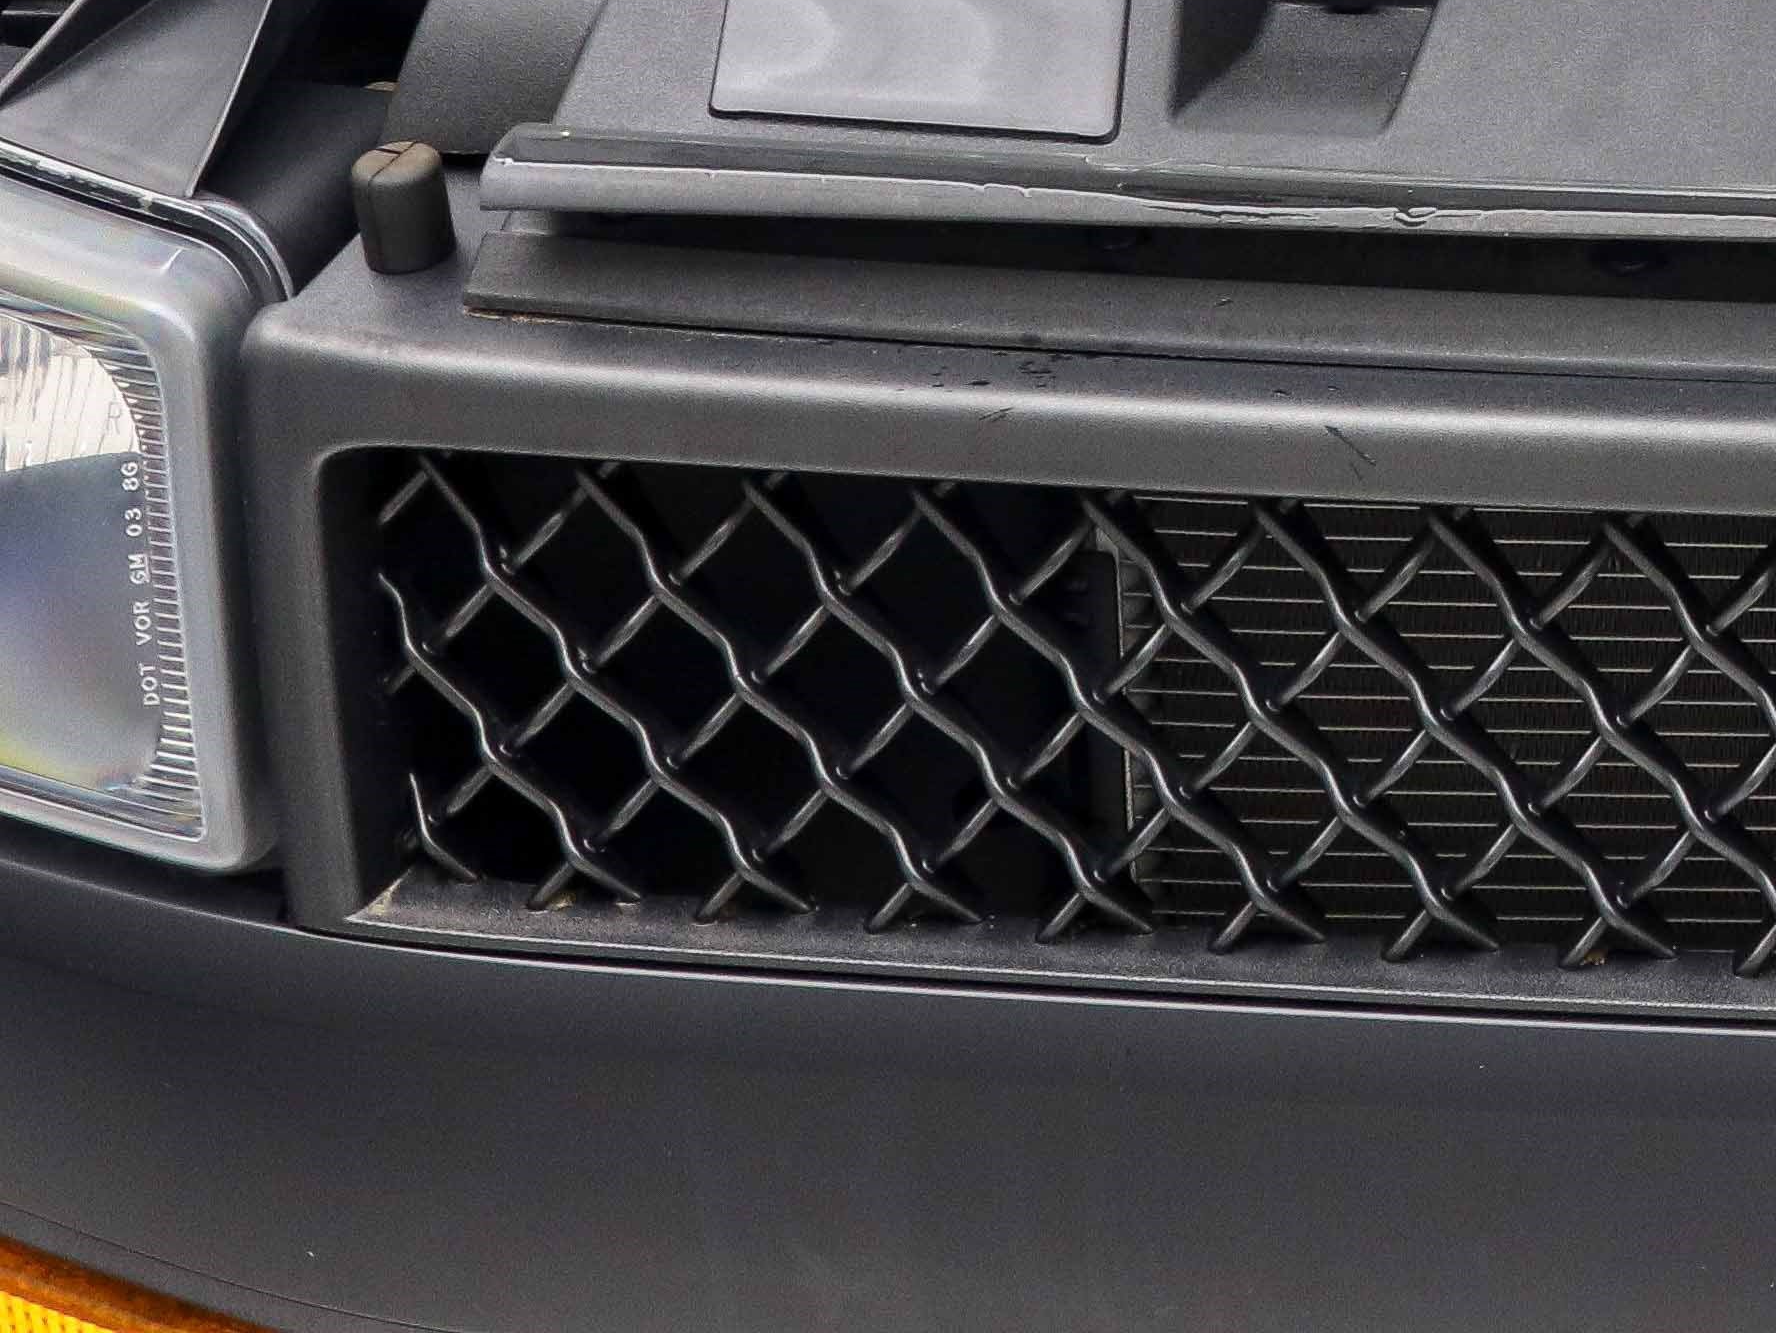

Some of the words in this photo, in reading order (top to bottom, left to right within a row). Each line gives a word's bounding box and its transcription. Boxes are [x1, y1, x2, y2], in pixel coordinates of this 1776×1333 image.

[121, 461, 139, 492] 8G
[125, 507, 142, 538] 03
[130, 553, 150, 586] GM
[133, 599, 153, 646] VOR
[143, 662, 162, 707] DOT
